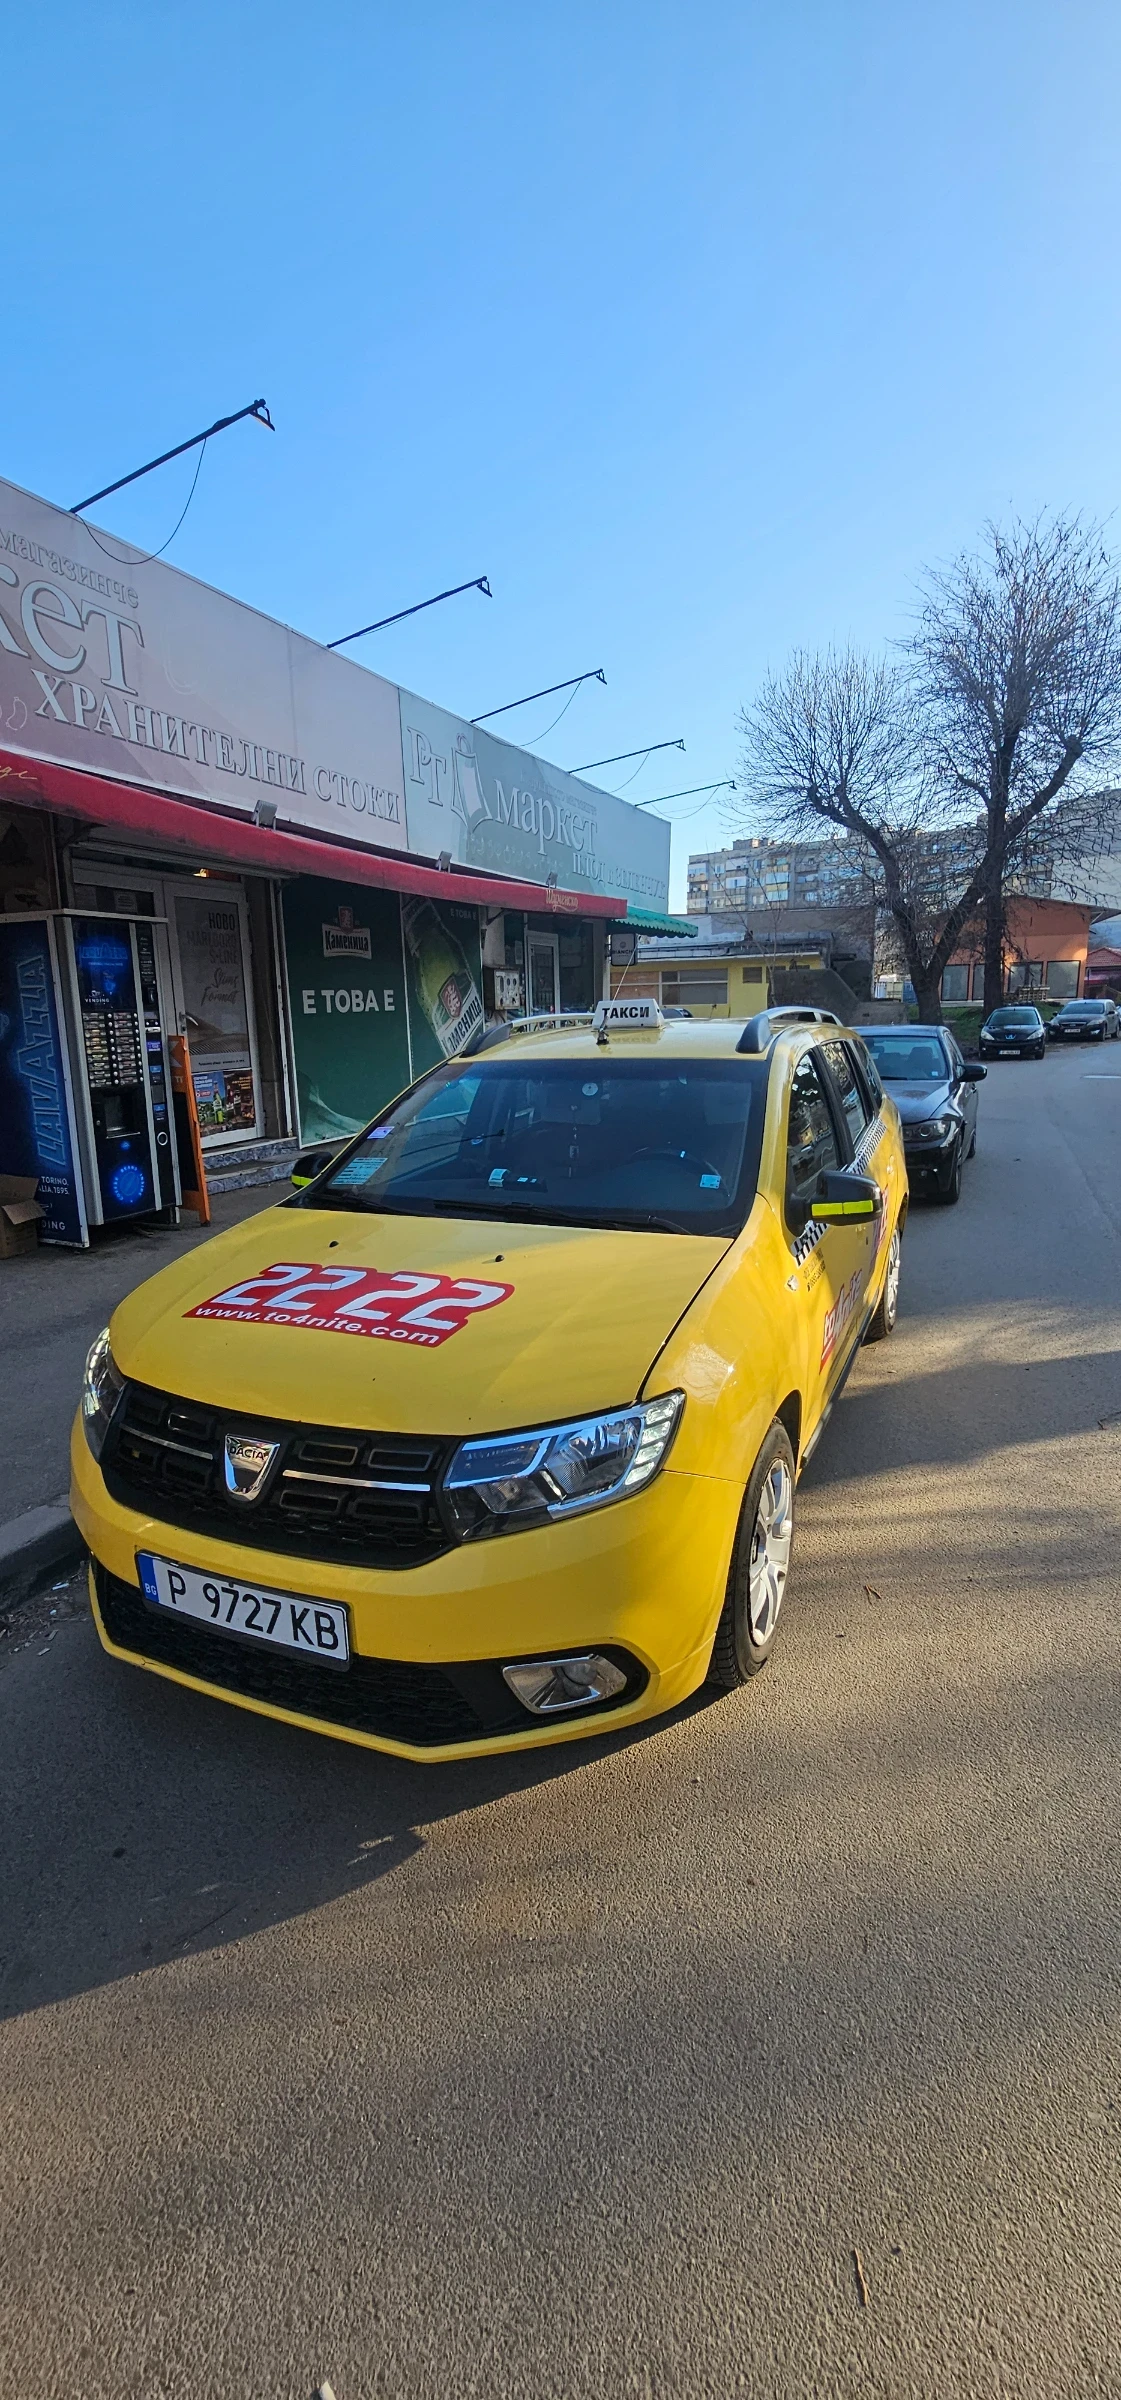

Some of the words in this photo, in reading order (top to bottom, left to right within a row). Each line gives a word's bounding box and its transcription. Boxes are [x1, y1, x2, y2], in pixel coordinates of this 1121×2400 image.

[31, 669, 307, 795] ХРАНИТЕЛНИ
[312, 765, 400, 825] СТОКИ
[494, 779, 598, 856] маркет
[208, 912, 236, 931] НОВО
[325, 929, 369, 952] Каменица
[201, 985, 240, 1007] Format
[302, 989, 317, 1014] Е
[321, 990, 379, 1013] ТОВА
[384, 989, 396, 1012] Е
[602, 1007, 650, 1019] ТАКСИ
[16, 954, 67, 1166] LAVAZZA
[196, 1307, 440, 1344] www.to4nite.com
[229, 1445, 265, 1461] DACIA
[145, 1582, 157, 1596] BG
[168, 1570, 186, 1604] P
[202, 1581, 281, 1634] 9727
[290, 1604, 339, 1651] KB
